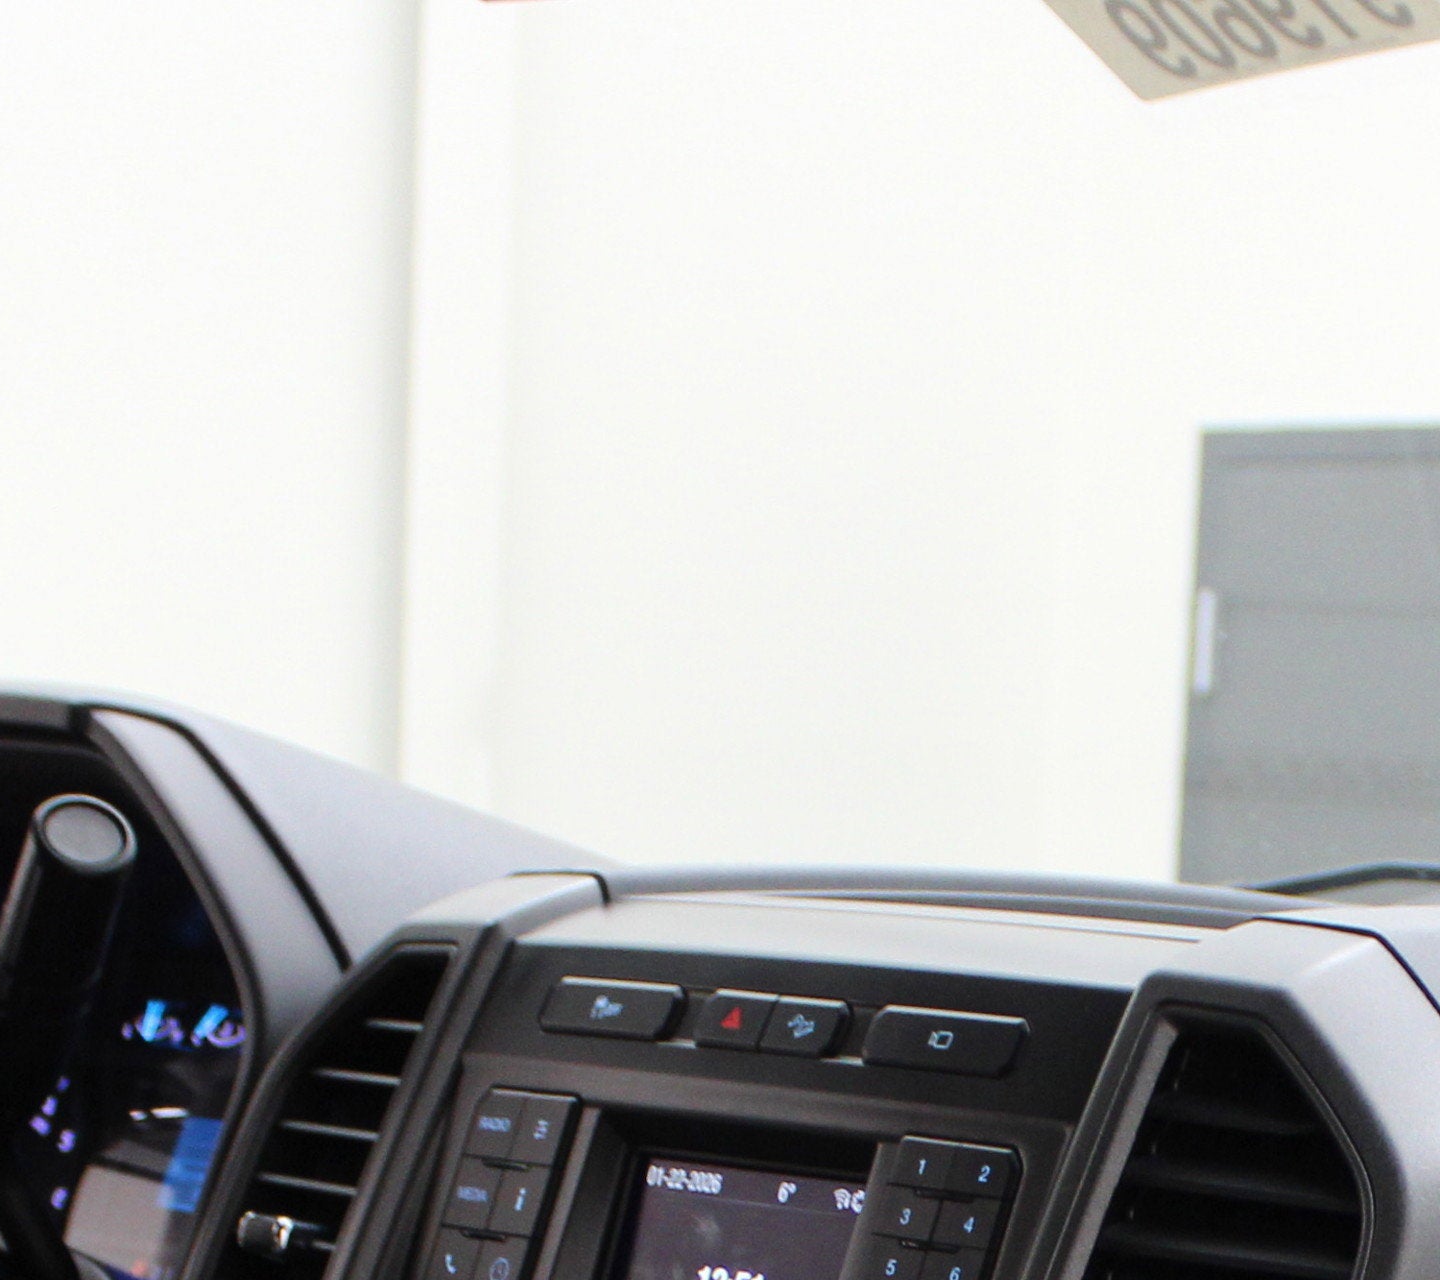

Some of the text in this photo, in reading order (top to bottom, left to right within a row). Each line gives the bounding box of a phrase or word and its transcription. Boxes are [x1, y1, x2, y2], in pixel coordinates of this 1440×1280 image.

[917, 1158, 927, 1176] 1
[977, 1165, 991, 1184] 2
[899, 1207, 911, 1226] 3
[962, 1216, 976, 1234] 4
[885, 1258, 898, 1276] 5
